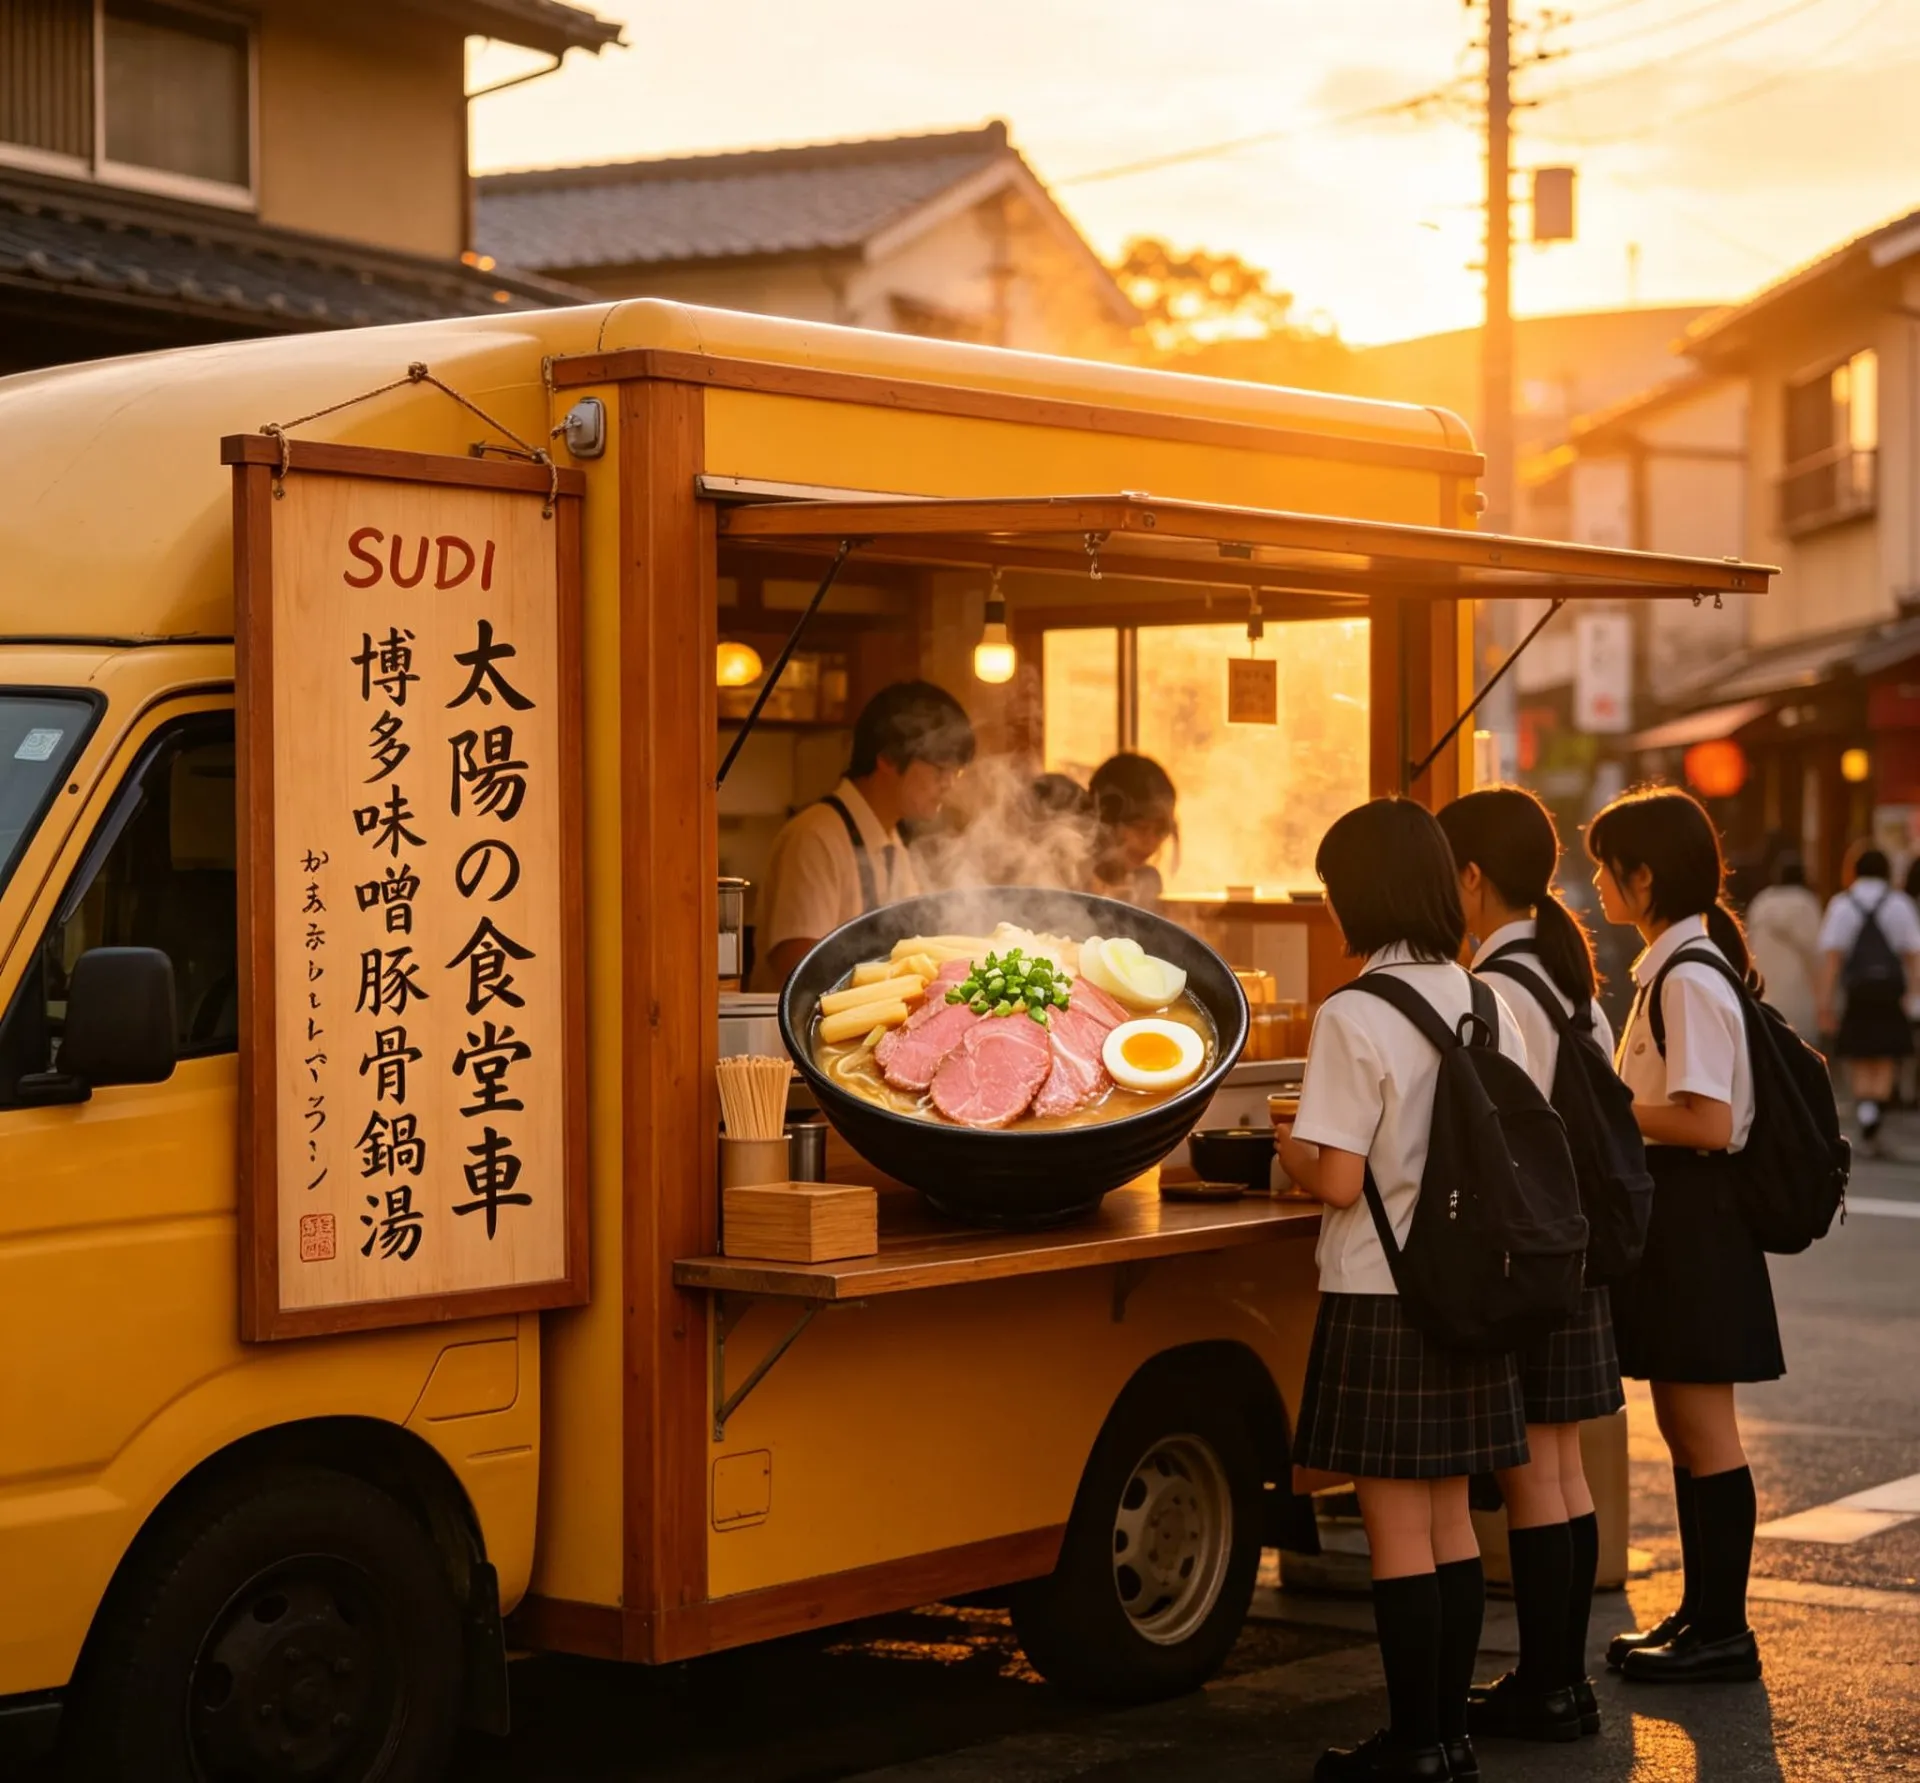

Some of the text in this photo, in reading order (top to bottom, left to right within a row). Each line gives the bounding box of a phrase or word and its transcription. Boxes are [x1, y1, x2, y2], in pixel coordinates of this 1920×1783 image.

[343, 526, 496, 592] SUDI
[350, 626, 430, 1263] 博多味噌豚骨鍋湯
[445, 619, 537, 1241] 太陽の食堂車
